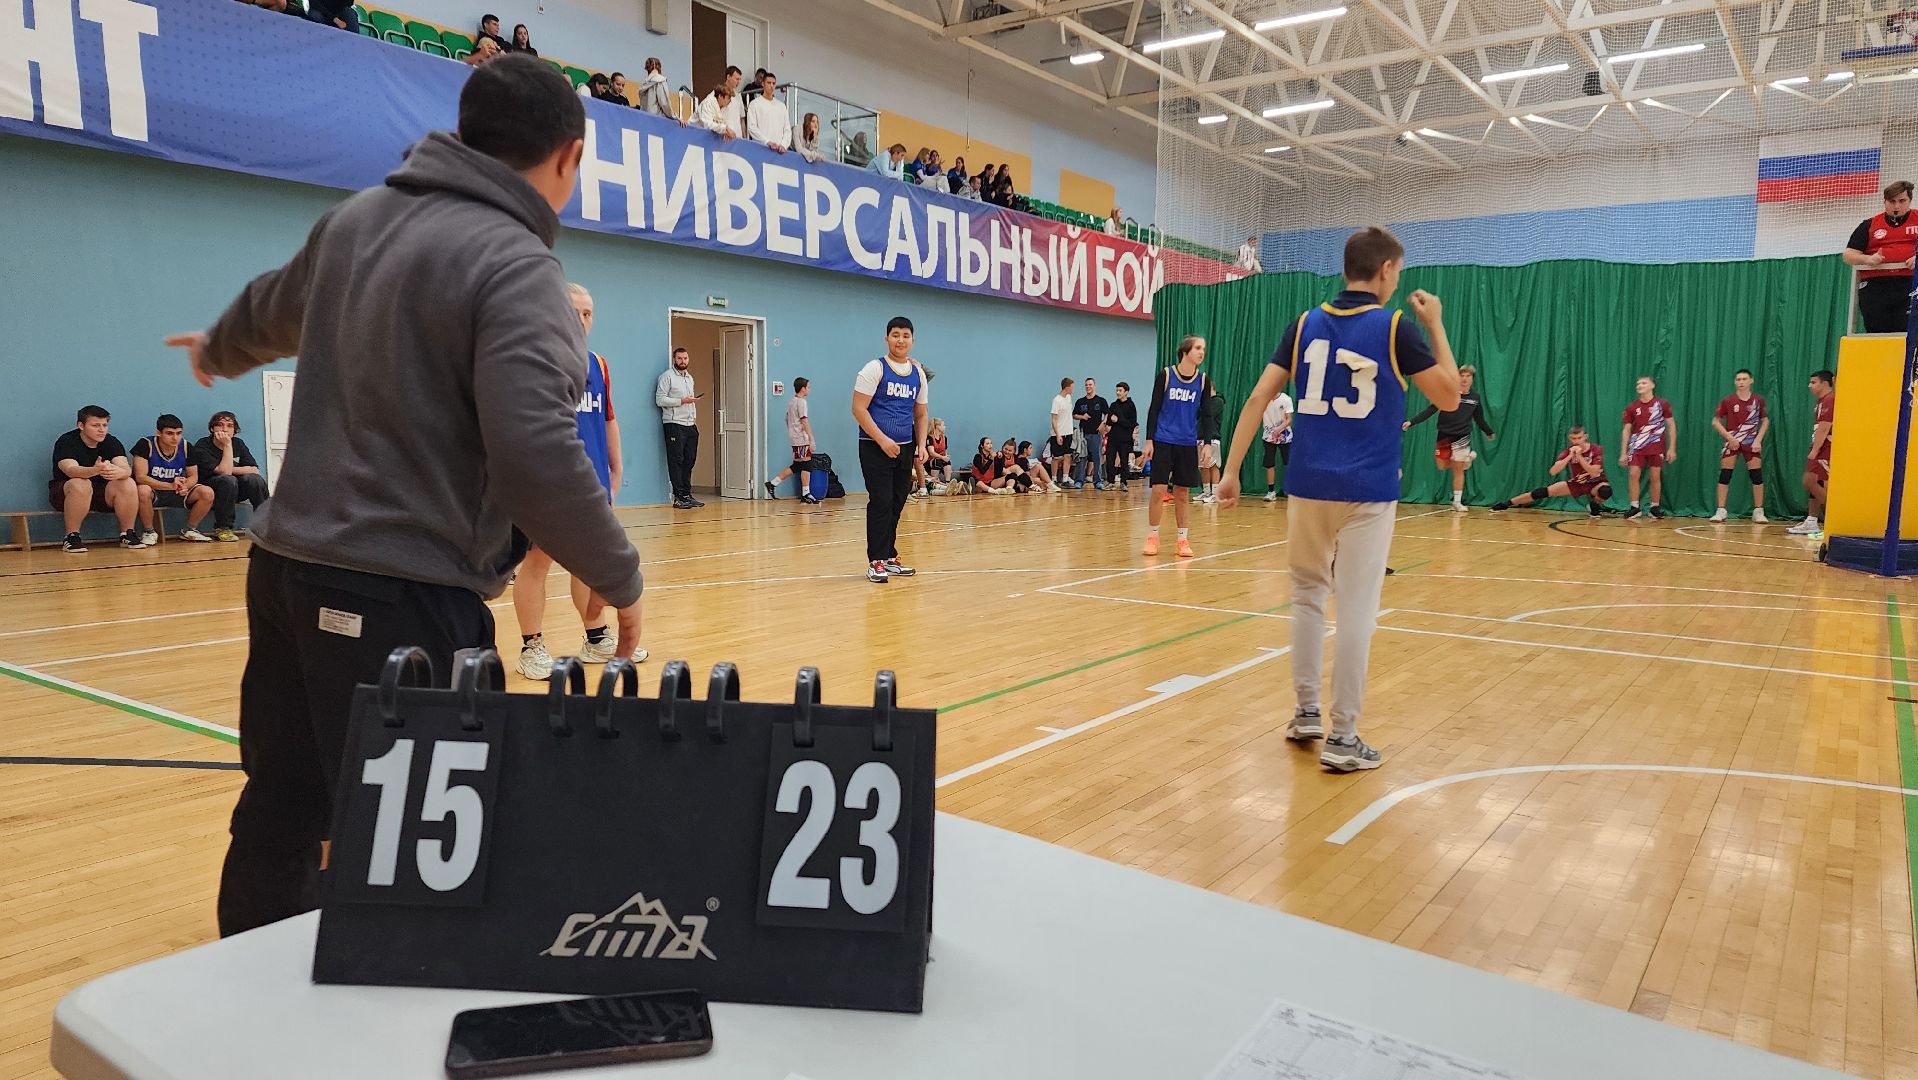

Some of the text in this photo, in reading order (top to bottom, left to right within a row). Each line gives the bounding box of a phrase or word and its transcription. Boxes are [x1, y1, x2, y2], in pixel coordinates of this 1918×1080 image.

[579, 118, 1165, 314] НИВЕРСАЛЬНЫЙ БОЙ
[575, 391, 602, 413] Ш-1
[886, 381, 917, 400] ВСШ-1
[1169, 387, 1197, 403] ВСШ-1
[1297, 338, 1379, 419] 13
[151, 465, 183, 479] ВСШ-1
[361, 738, 490, 892] 15
[766, 759, 902, 915] 23
